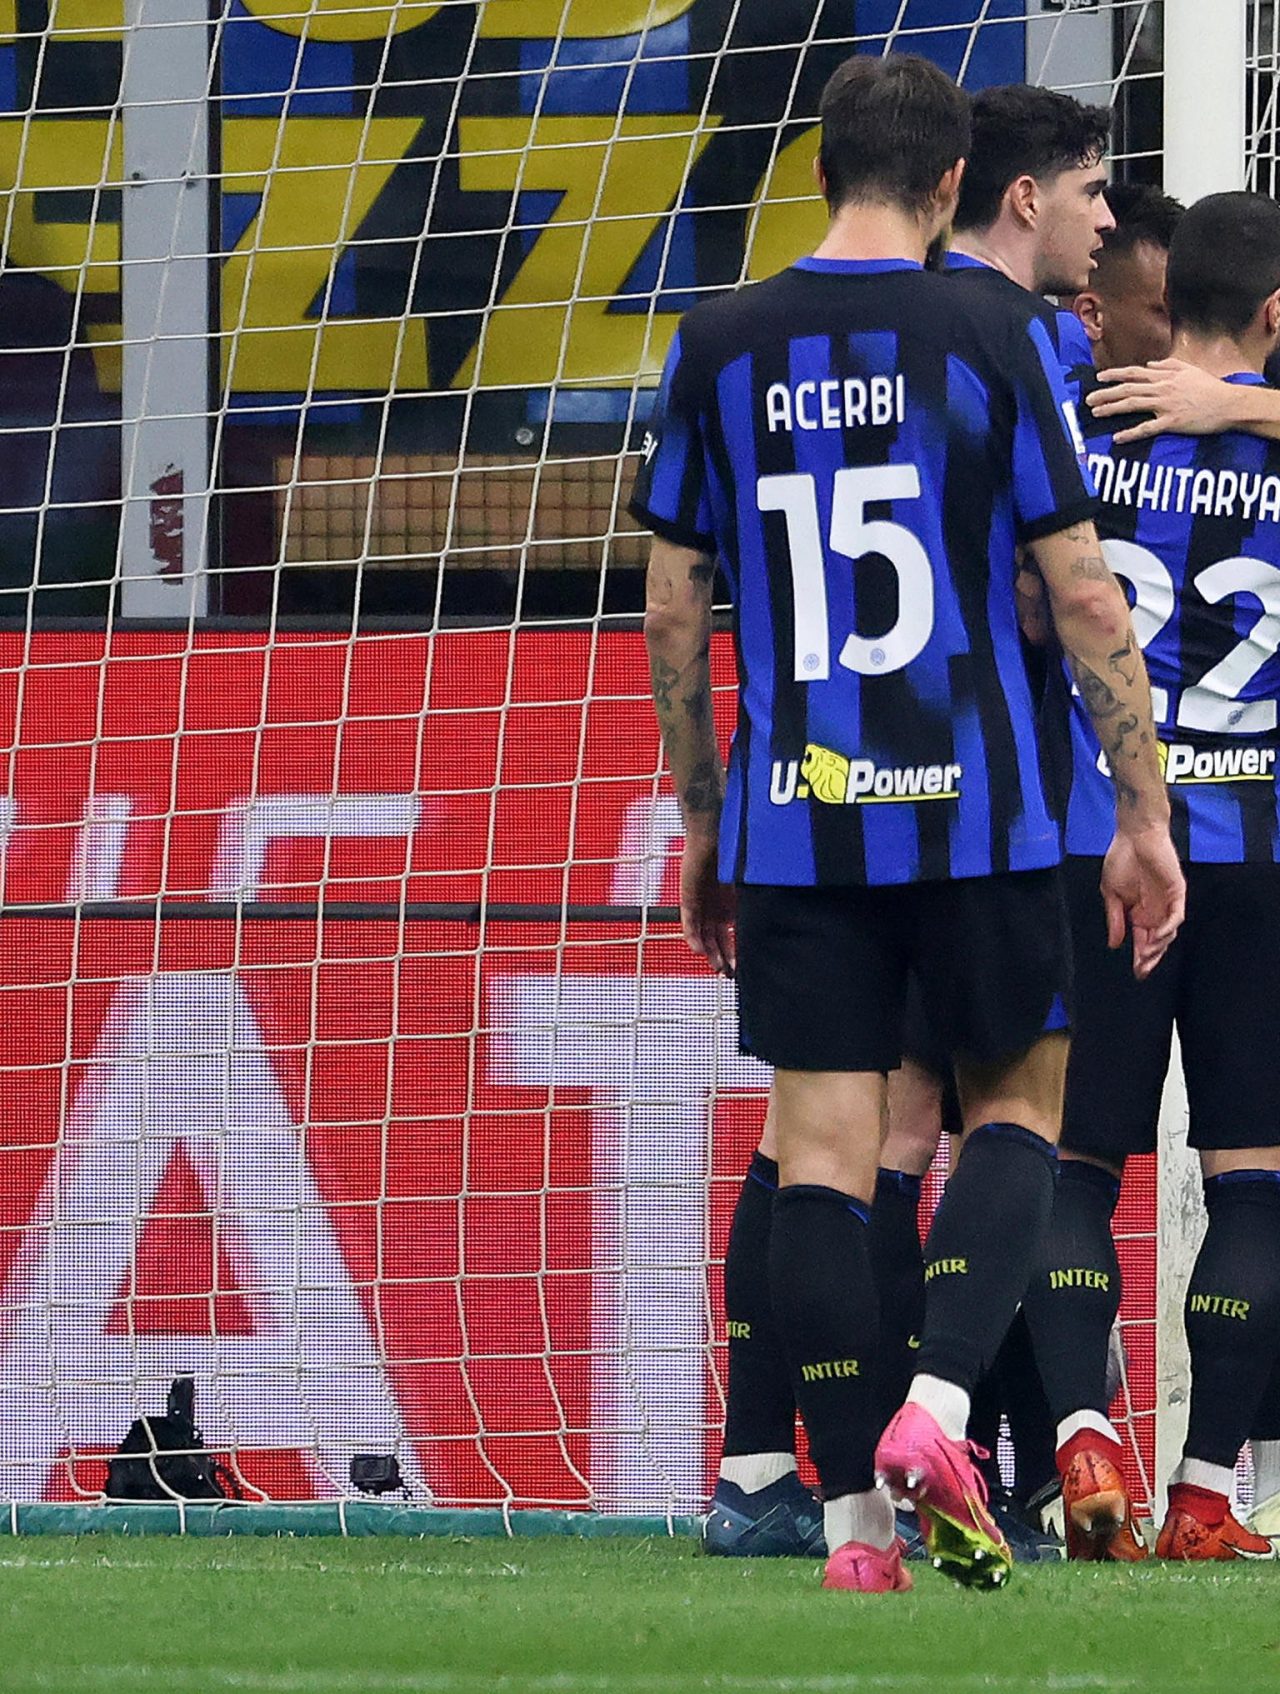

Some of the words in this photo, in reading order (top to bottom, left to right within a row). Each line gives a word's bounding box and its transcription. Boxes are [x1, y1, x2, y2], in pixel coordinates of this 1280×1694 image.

[766, 373, 905, 432] ACERBI
[757, 464, 934, 681] 15
[925, 1258, 968, 1285] NTER
[1049, 1268, 1109, 1292] INTER
[1190, 1294, 1250, 1320] INTER
[802, 1359, 860, 1382] INTER
